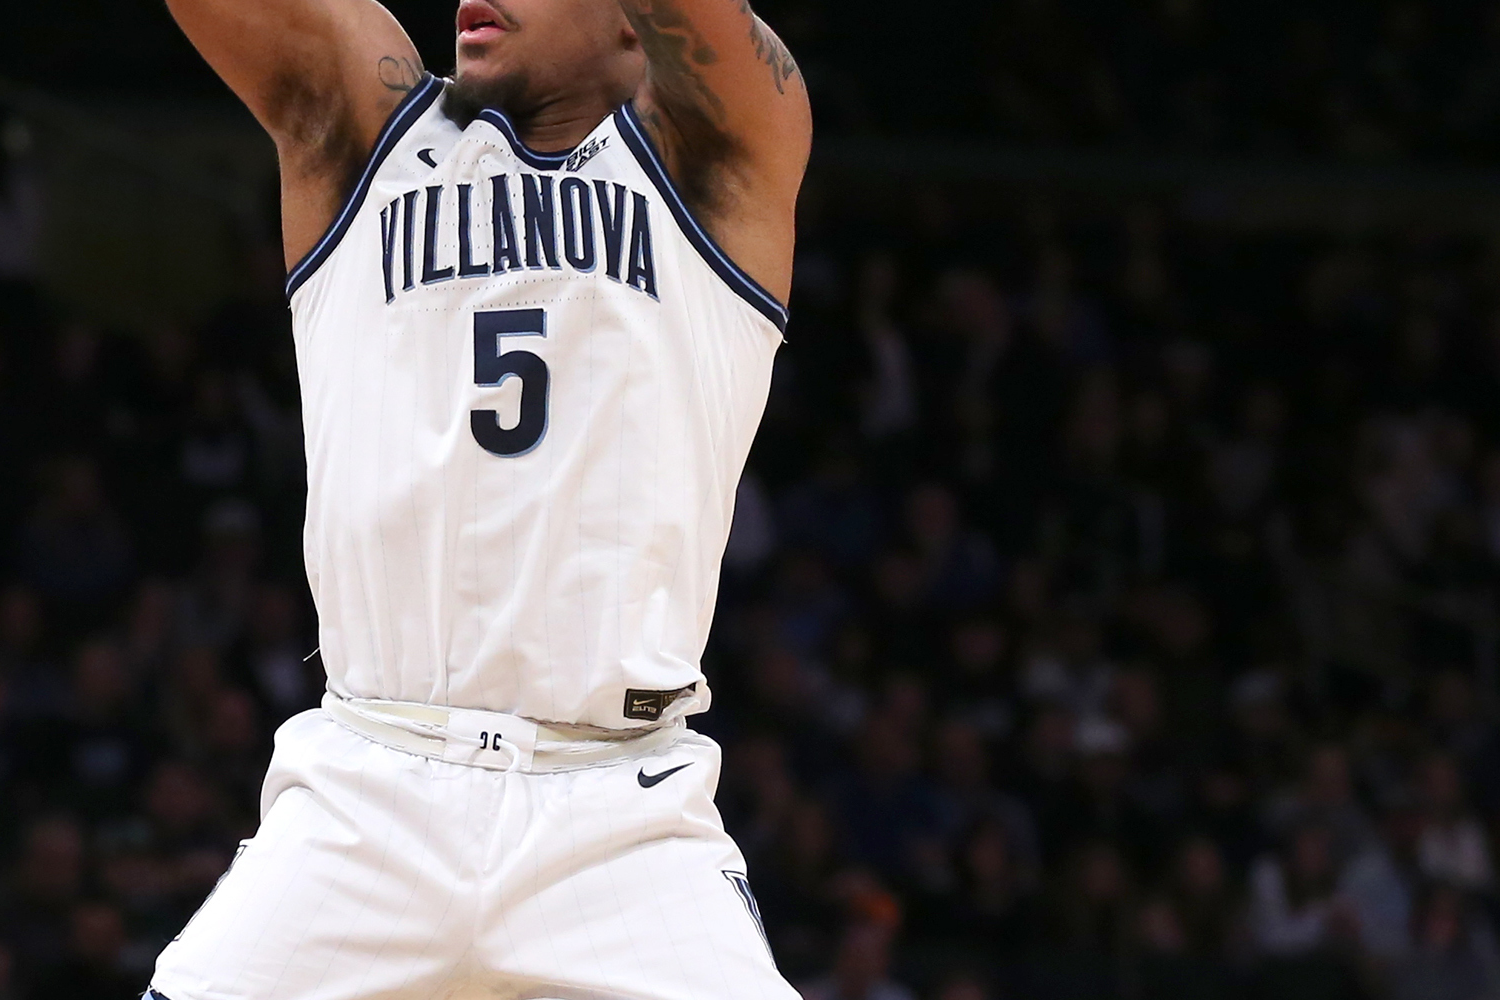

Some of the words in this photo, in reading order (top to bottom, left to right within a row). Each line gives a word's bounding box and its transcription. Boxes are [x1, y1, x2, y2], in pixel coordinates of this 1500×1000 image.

[566, 136, 597, 167] BIG
[380, 173, 660, 305] VILLANOVA
[470, 308, 550, 458] 5
